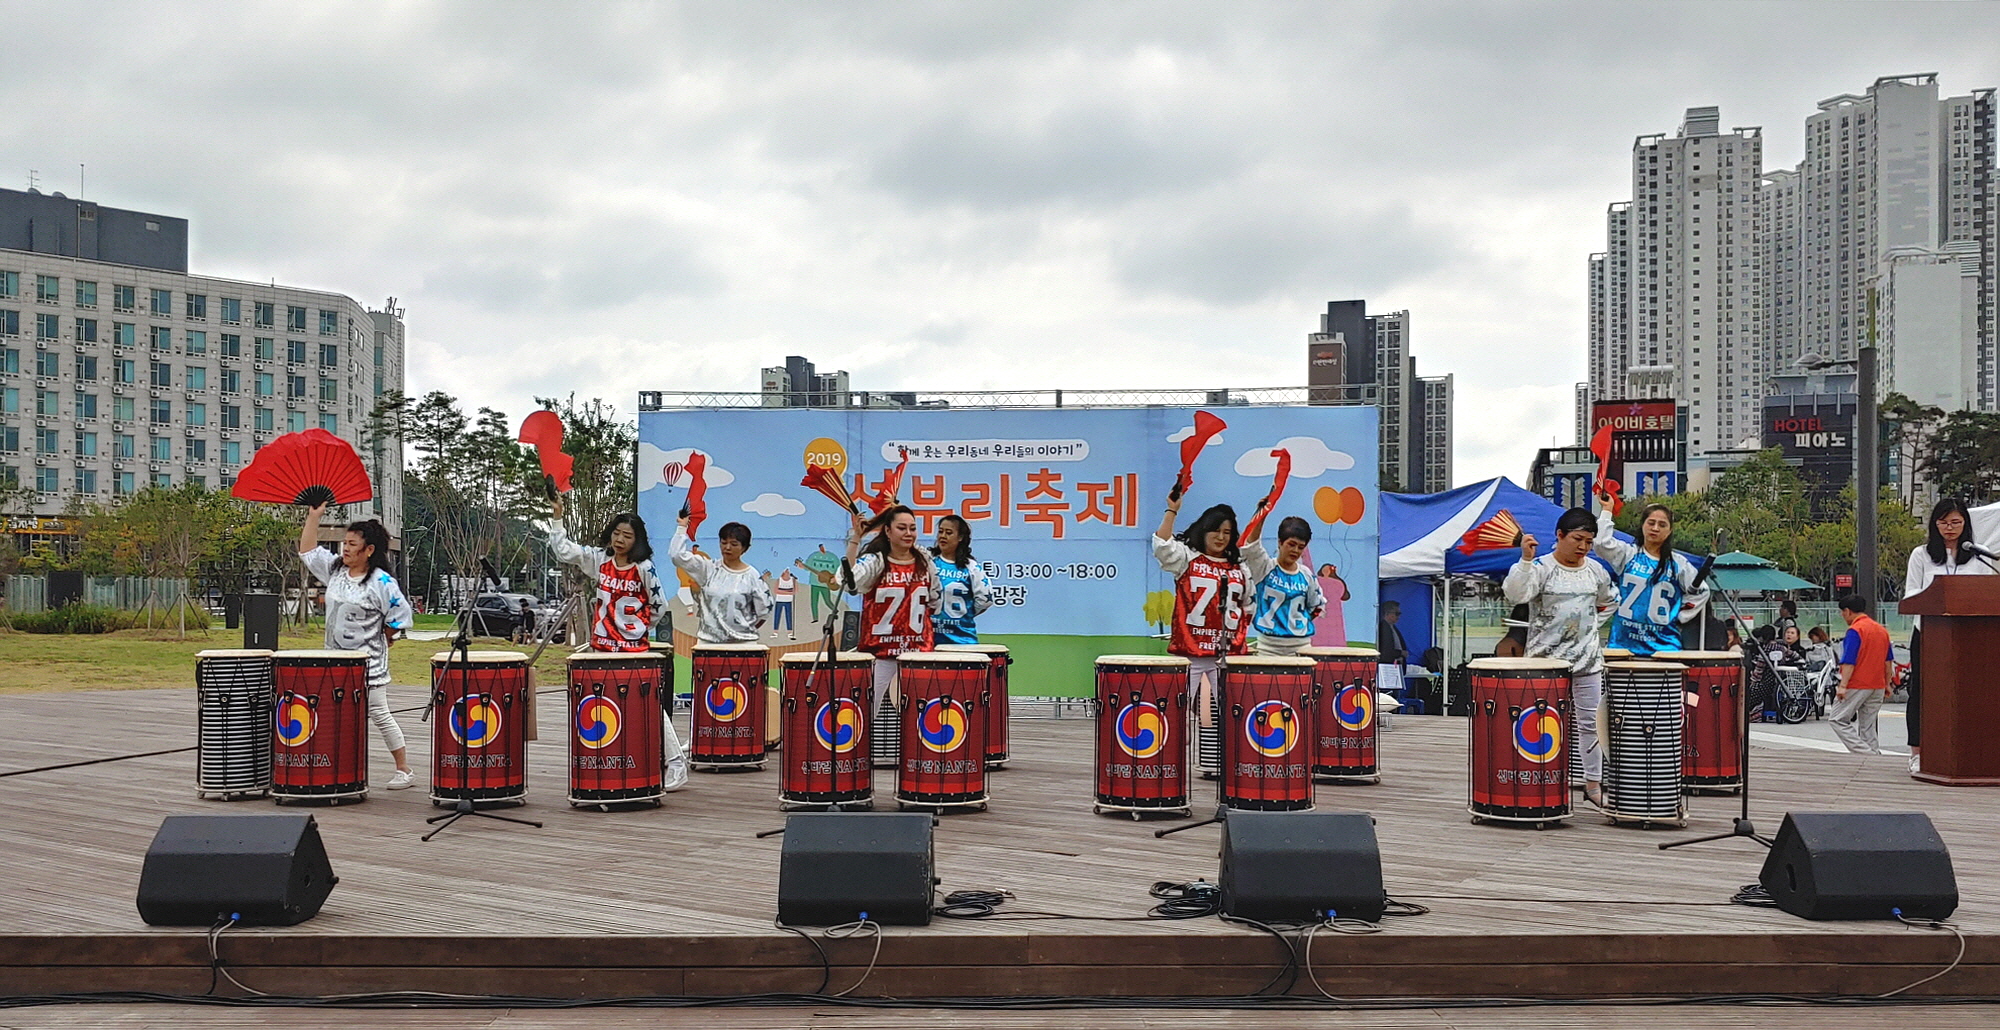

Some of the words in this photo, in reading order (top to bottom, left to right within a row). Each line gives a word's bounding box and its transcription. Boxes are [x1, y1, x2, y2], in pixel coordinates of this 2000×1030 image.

[1774, 418, 1824, 432] HOTEL
[1795, 432, 1846, 448] 피아노
[923, 445, 942, 458] 웃는
[945, 444, 989, 458] 우리동네
[992, 443, 1034, 458] 우리들의
[807, 452, 841, 466] 2019
[1006, 564, 1052, 578] 13:00
[944, 582, 969, 618] 6
[991, 586, 1027, 606] 광장
[1186, 576, 1245, 630] 76
[1618, 572, 1676, 625] 76
[871, 586, 930, 635] 76
[1257, 585, 1308, 637] 76
[617, 639, 640, 648] STATE
[285, 753, 331, 767] NANTA
[587, 755, 636, 769] NANTA
[934, 760, 978, 774] NANTA
[1133, 764, 1178, 779] NANTA
